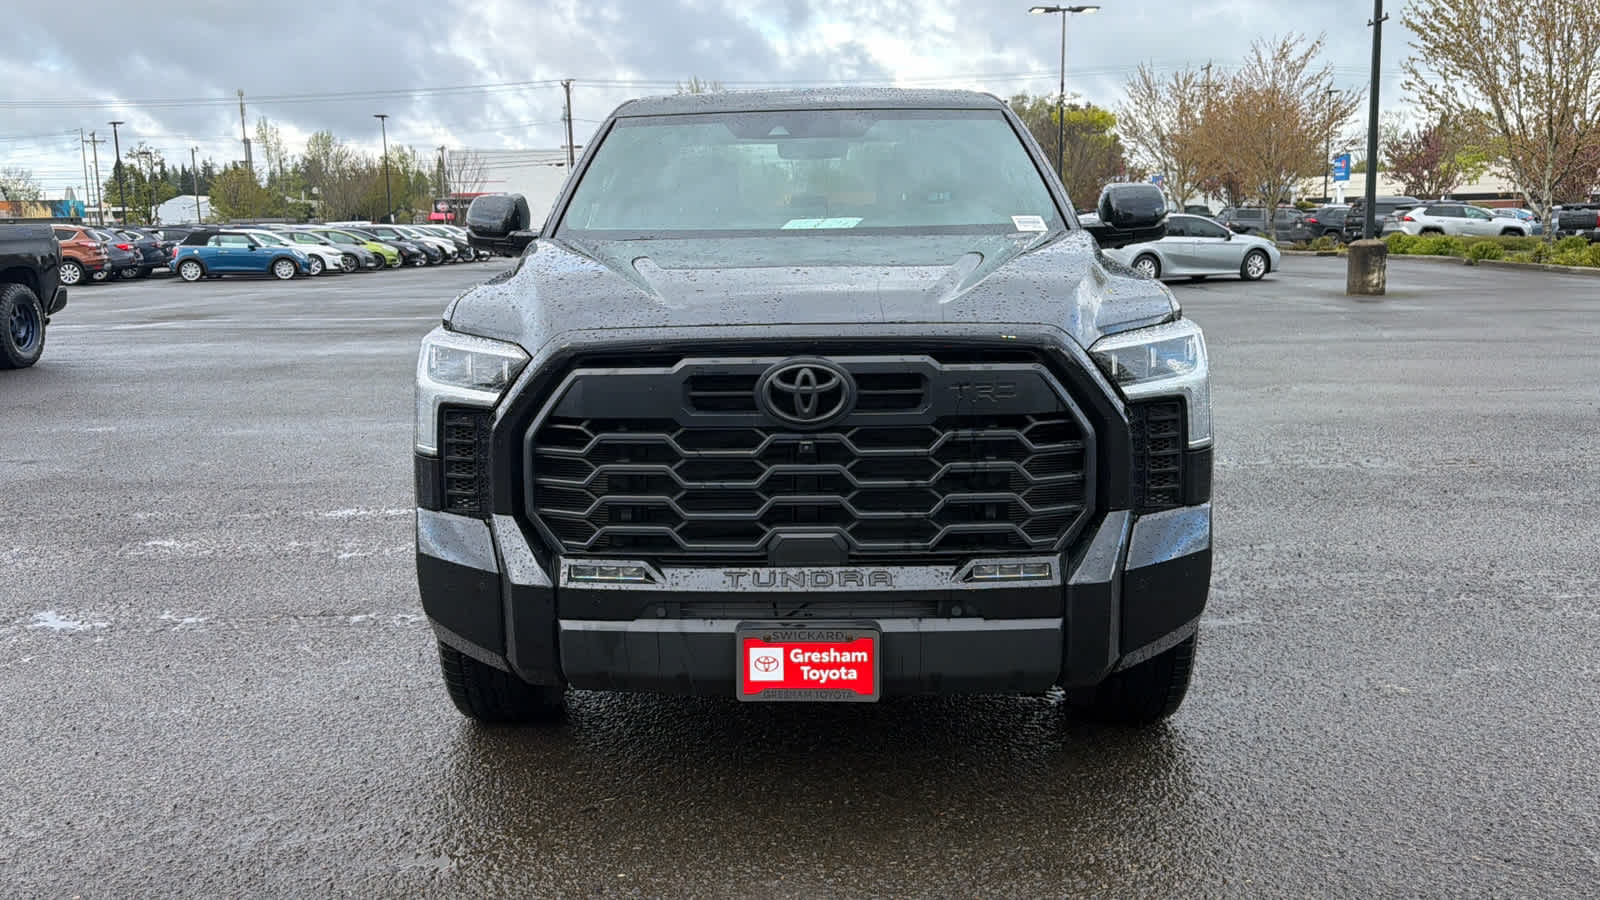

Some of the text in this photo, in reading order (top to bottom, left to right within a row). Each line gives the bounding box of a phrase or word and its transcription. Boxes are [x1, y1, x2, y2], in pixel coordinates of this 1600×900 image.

[723, 571, 894, 588] TUNDRA
[771, 631, 846, 641] SWICKARD
[789, 648, 869, 663] Gresham
[799, 665, 858, 684] Toyota
[762, 689, 853, 700] GRESHAM TOYOTA
